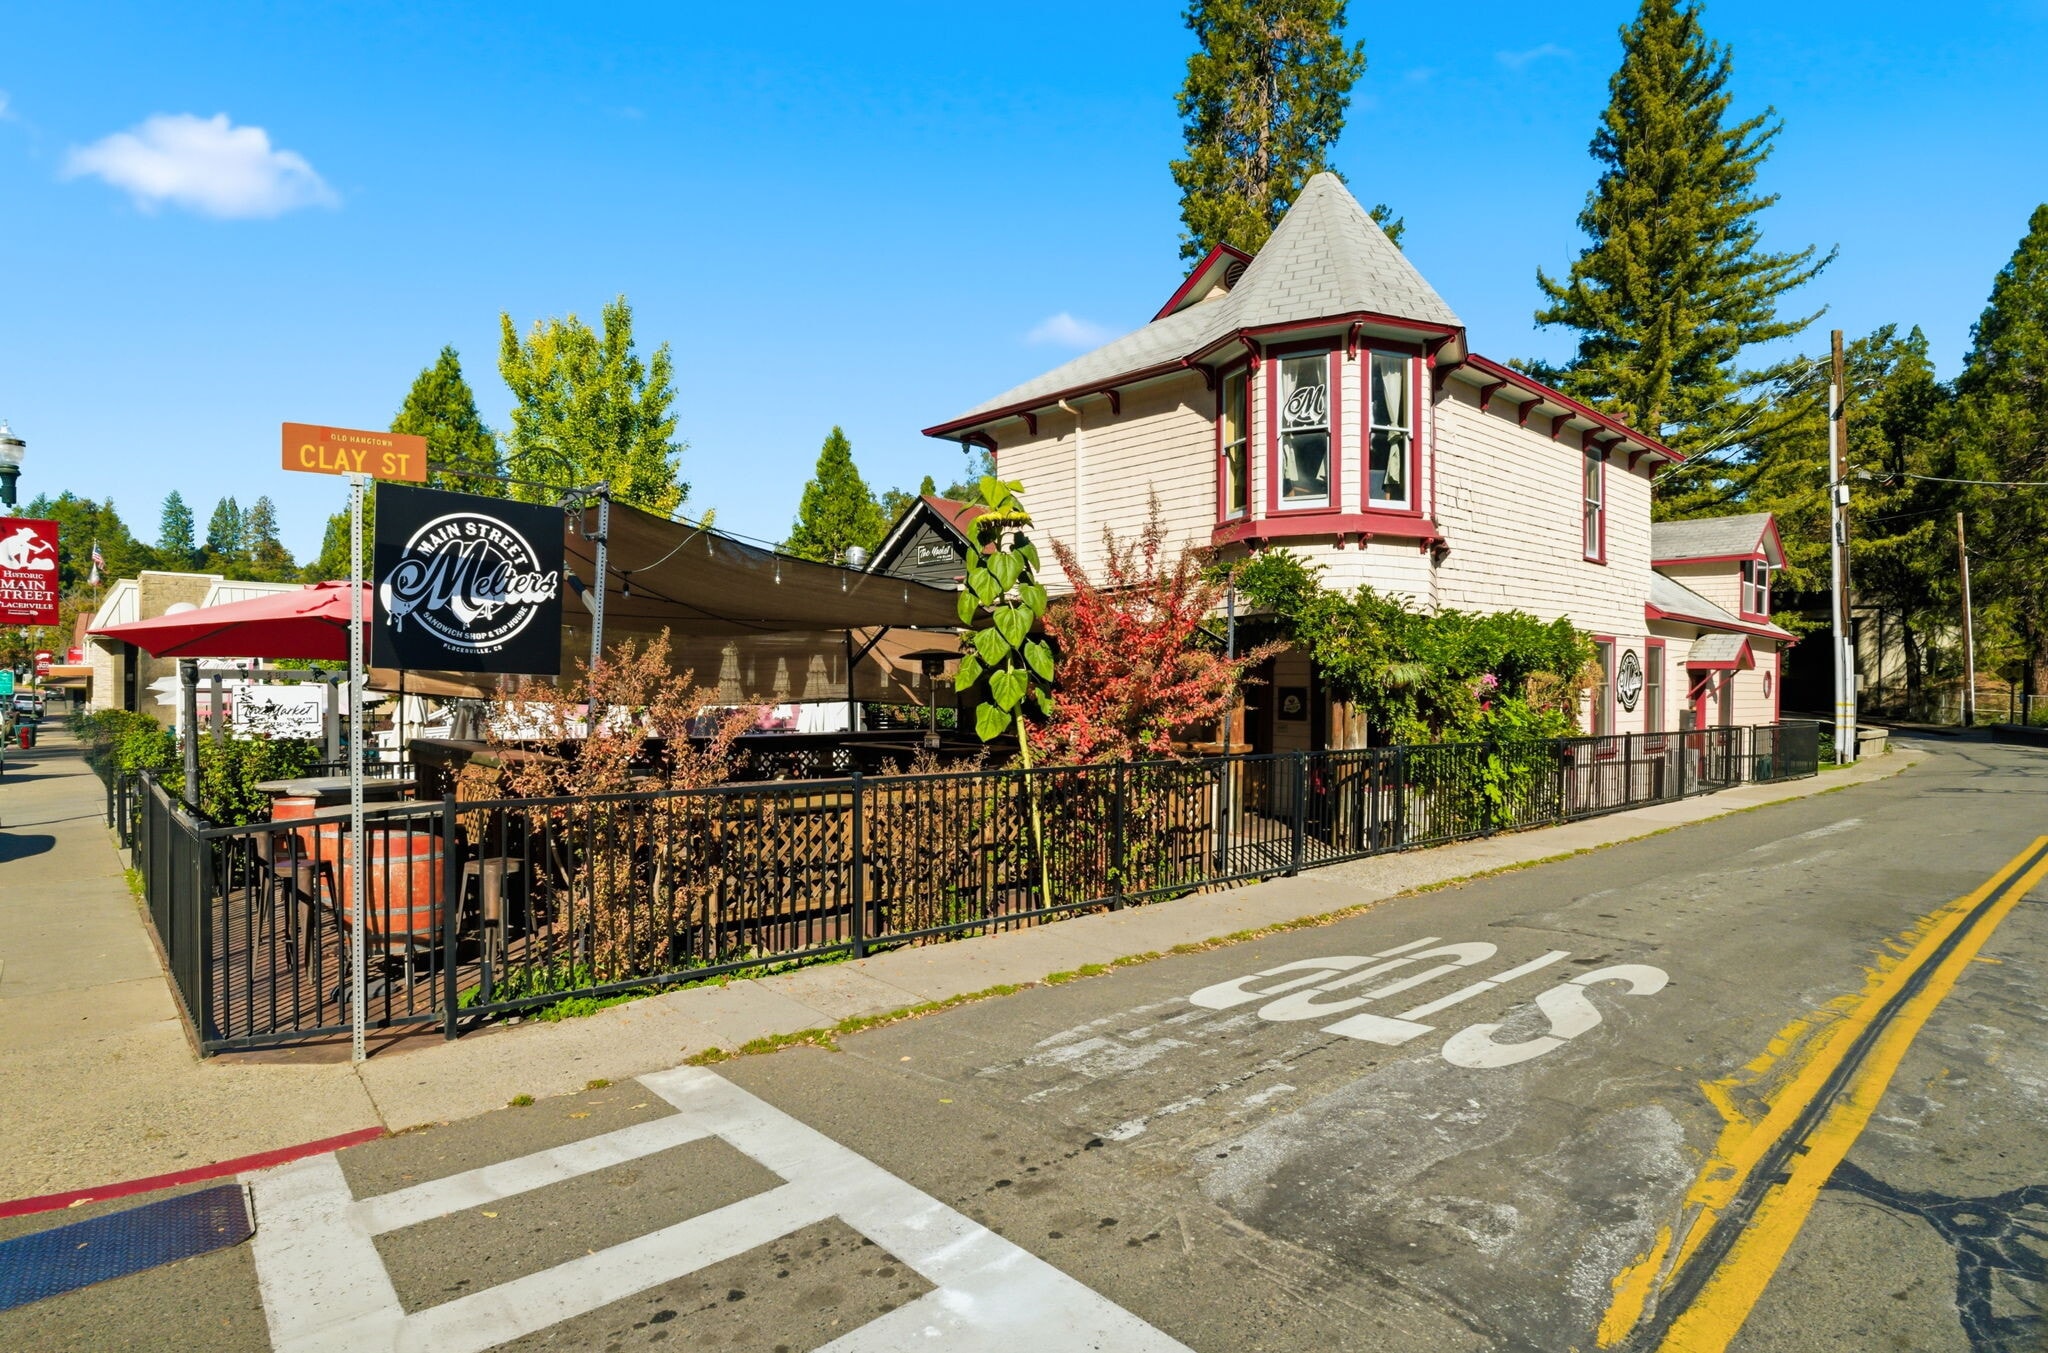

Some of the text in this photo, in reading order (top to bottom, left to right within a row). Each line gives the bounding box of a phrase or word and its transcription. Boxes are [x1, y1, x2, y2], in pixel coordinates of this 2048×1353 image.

[330, 433, 393, 447] OLD HANGTOWN
[300, 444, 411, 476] CLAY ST
[417, 521, 529, 566] MAIN STREET
[386, 538, 558, 614] Melters
[0, 589, 55, 601] TREET
[423, 606, 528, 641] SANDWICH SHOP & TAP HOUSE
[1189, 936, 1670, 1069] STOP
